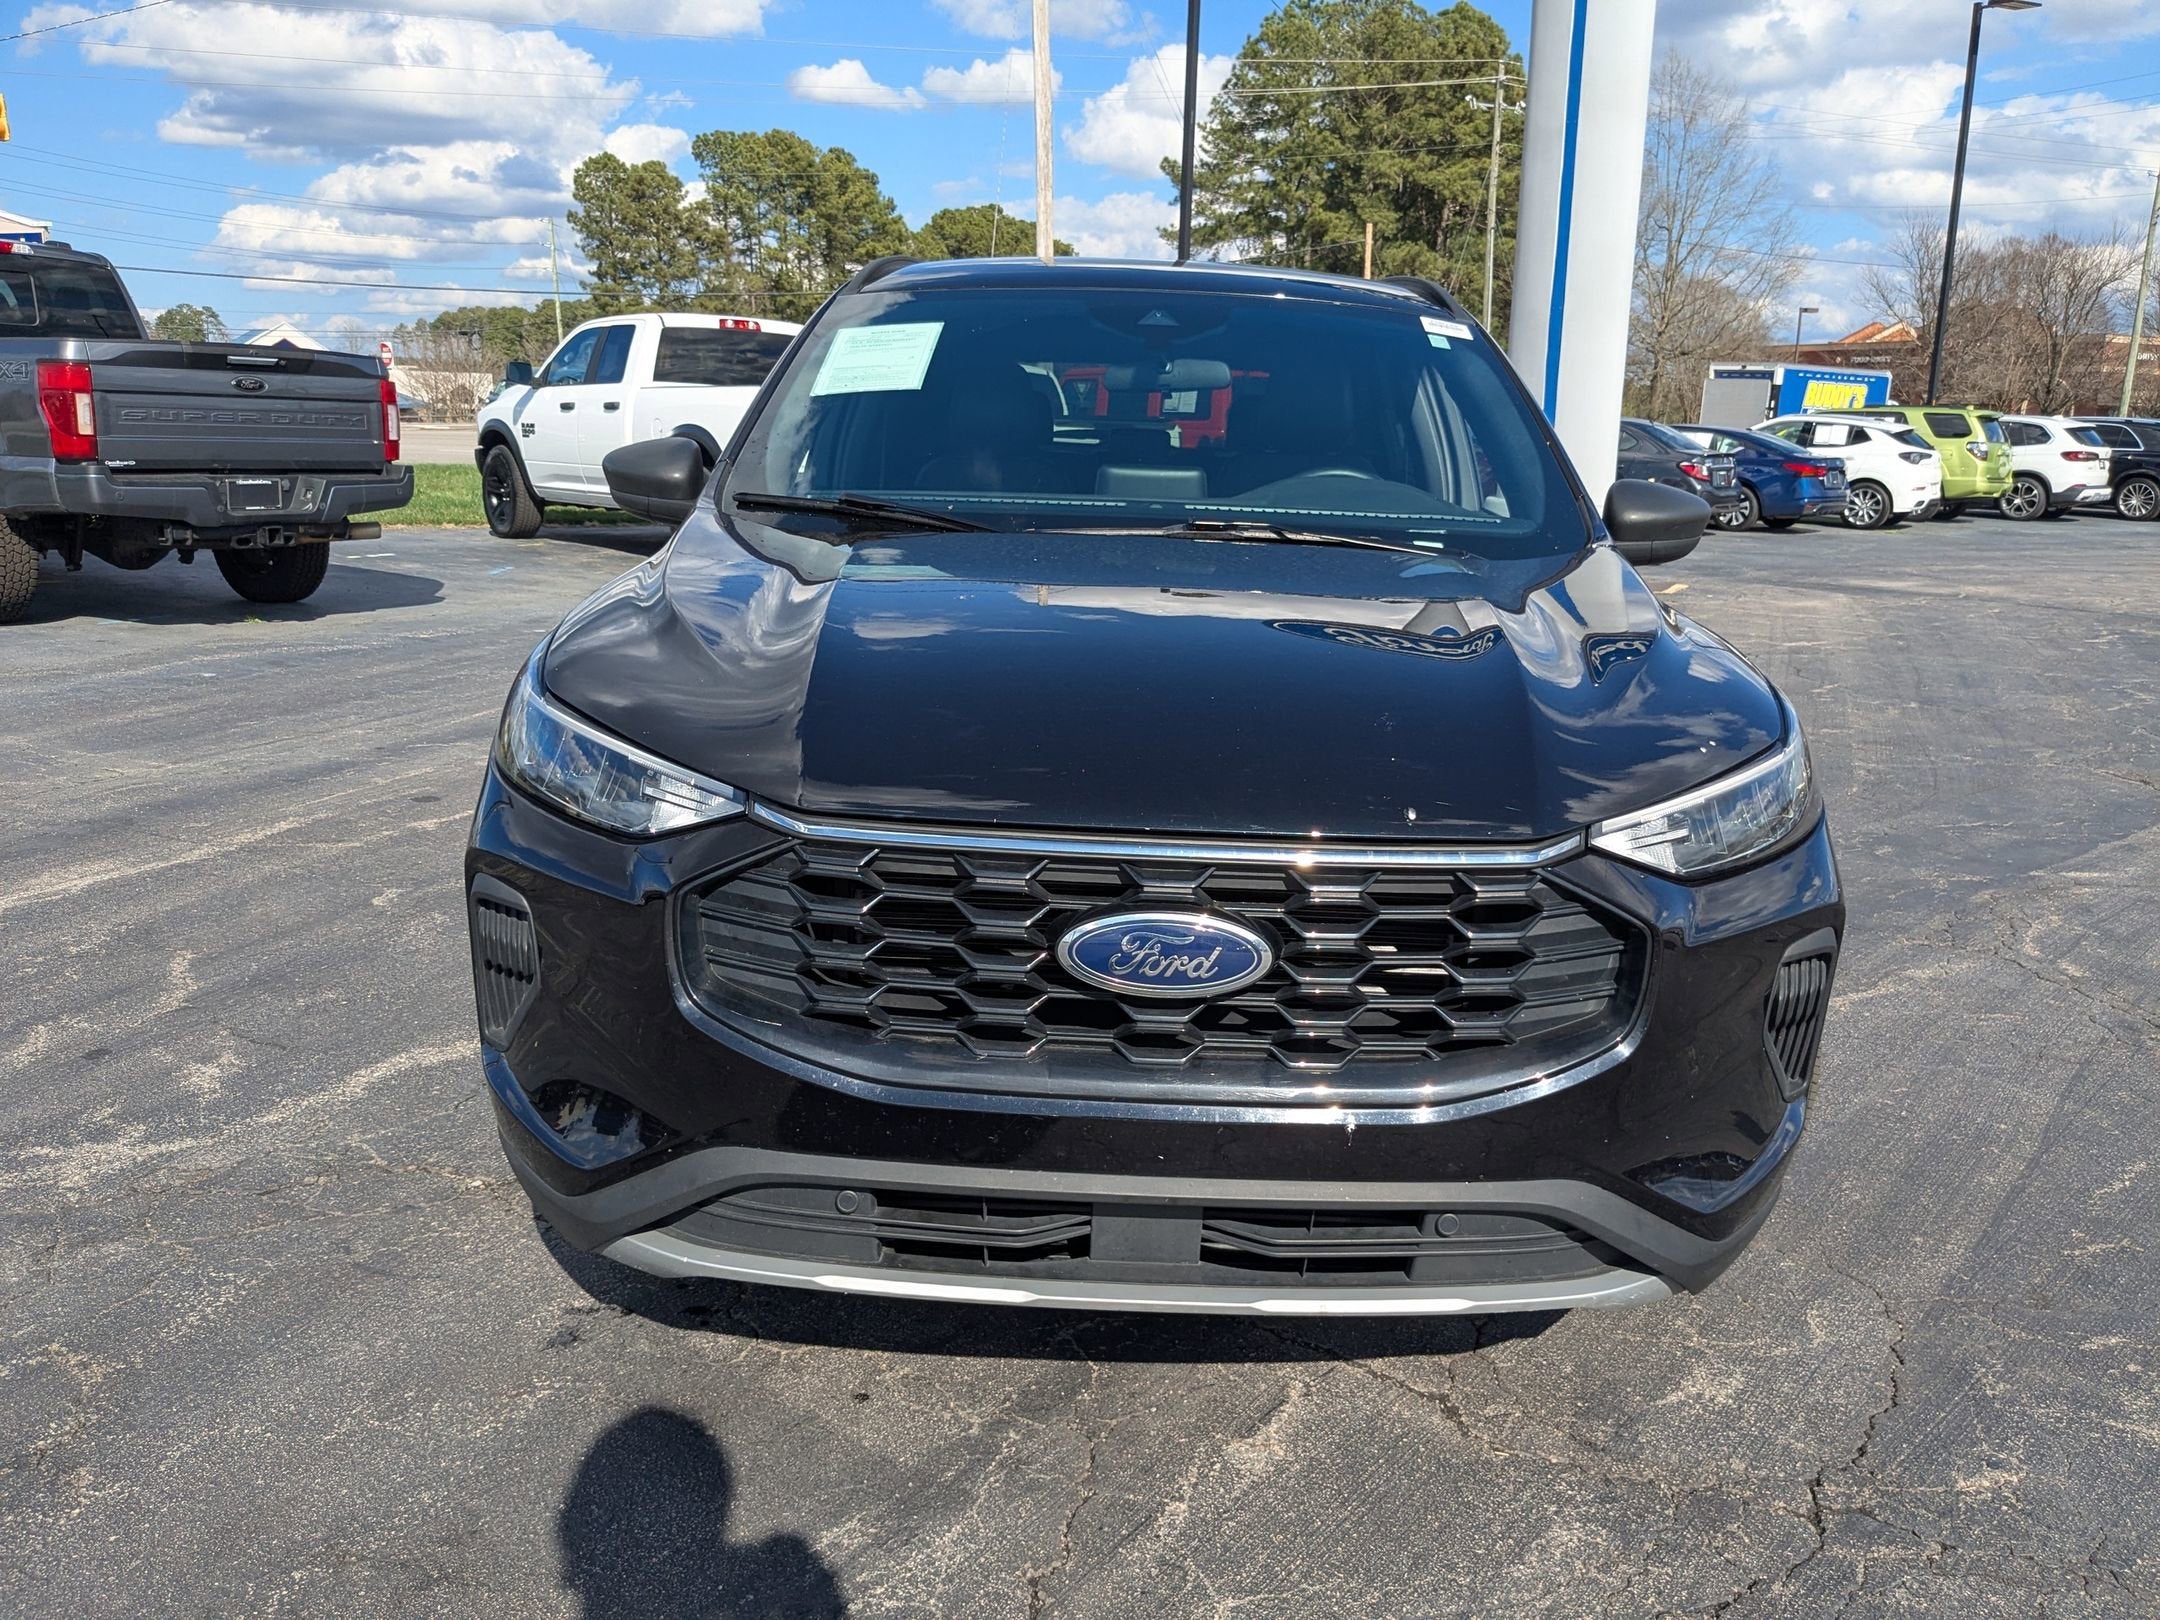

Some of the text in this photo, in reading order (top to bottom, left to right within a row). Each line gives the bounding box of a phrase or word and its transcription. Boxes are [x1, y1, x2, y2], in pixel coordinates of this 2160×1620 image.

[1803, 380, 1868, 409] BUDDY'S
[121, 409, 362, 427] SUPER DUTY
[1108, 931, 1222, 978] Ford
